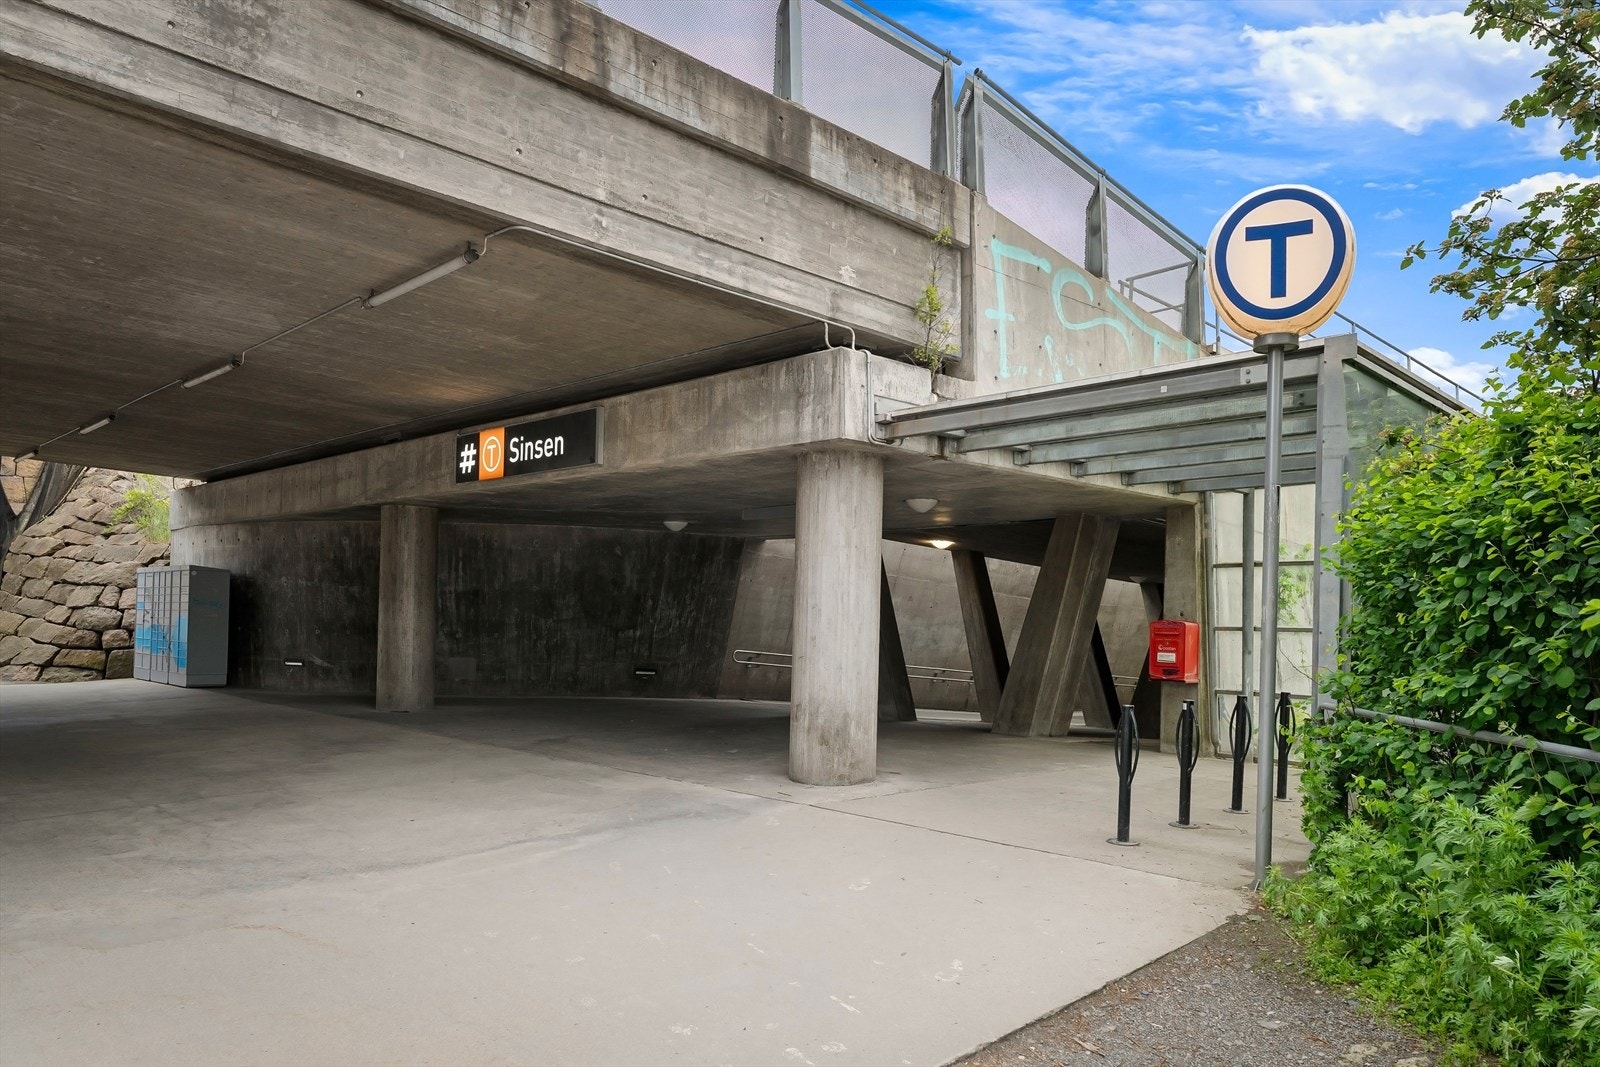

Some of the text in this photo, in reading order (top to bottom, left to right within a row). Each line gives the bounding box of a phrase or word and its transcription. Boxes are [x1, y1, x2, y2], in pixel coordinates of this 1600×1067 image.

[1245, 218, 1314, 299] T
[459, 435, 564, 474] # T Sinsen
